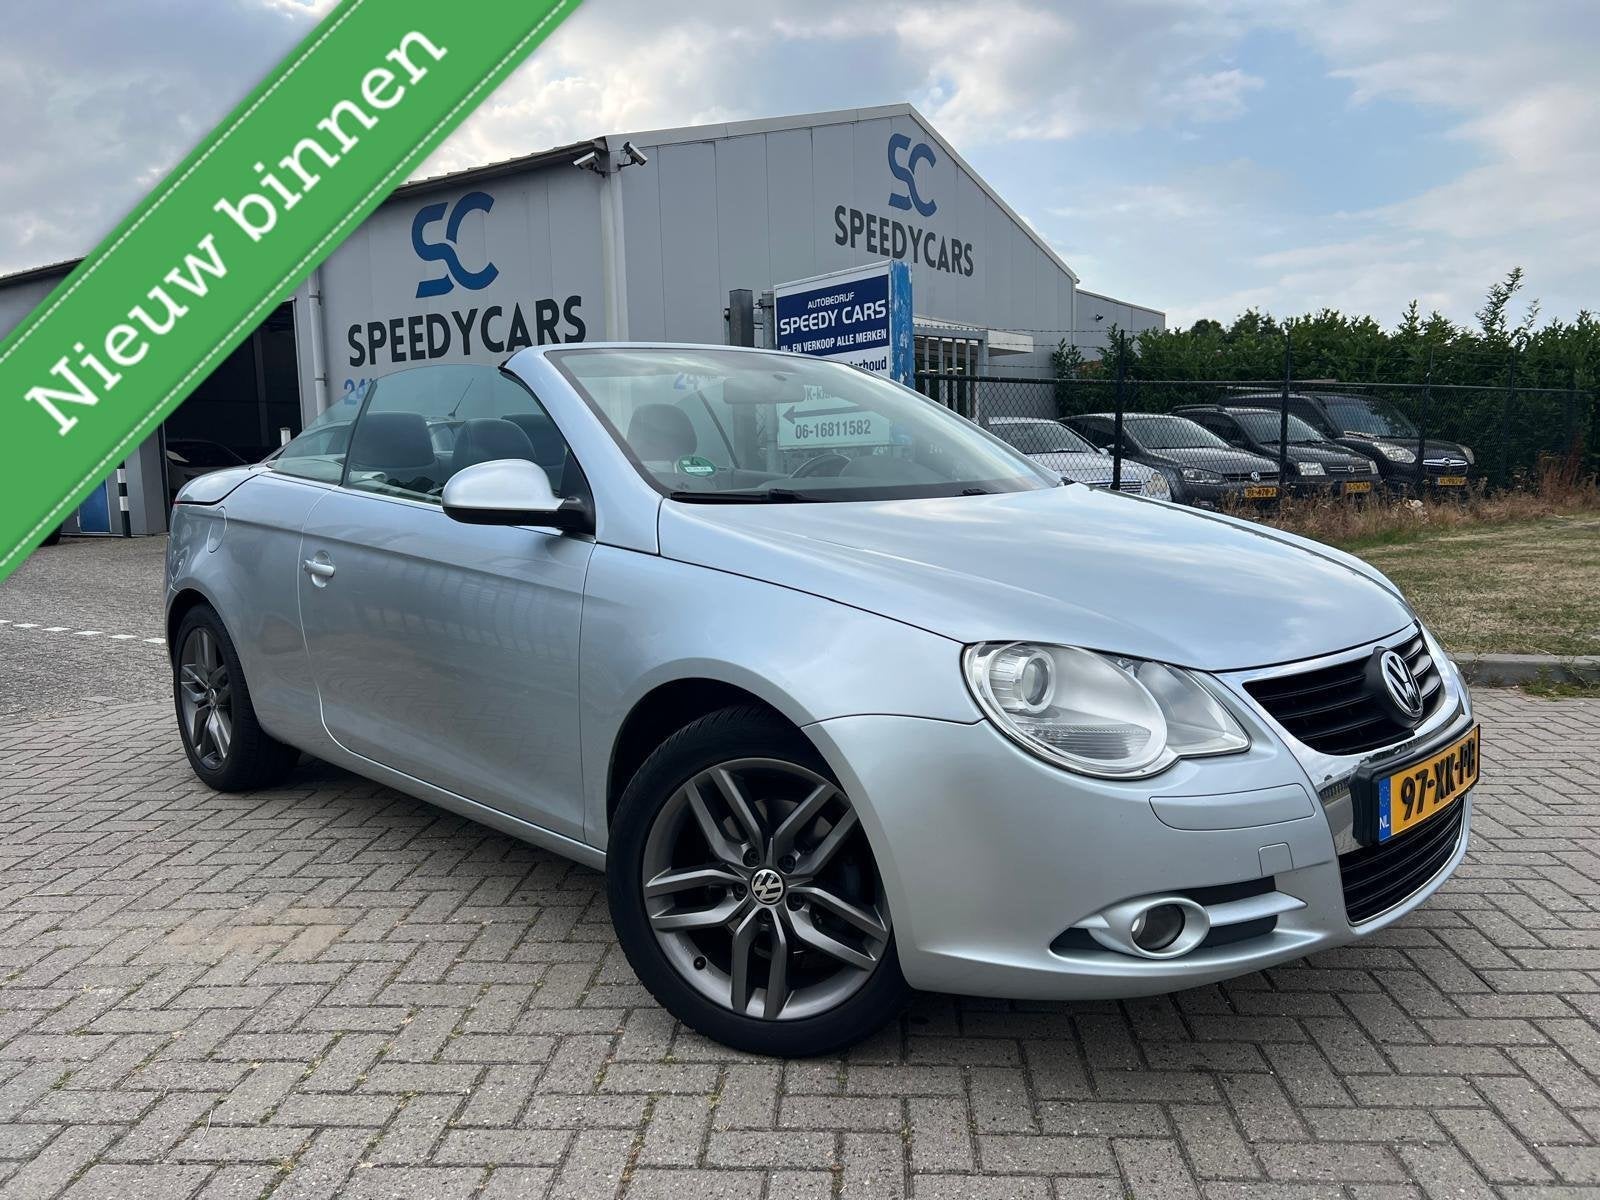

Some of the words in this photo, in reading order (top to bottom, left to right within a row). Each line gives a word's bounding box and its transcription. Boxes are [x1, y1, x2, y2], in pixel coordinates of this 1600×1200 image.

[834, 204, 975, 278] SPEEDYCARS
[807, 291, 856, 310] AUTOBEDRIJF
[780, 308, 839, 336] SPEEDY
[841, 299, 887, 325] CARS
[347, 295, 587, 368] SPEEDYCARS
[802, 337, 835, 353] VERKOOP
[836, 333, 855, 348] ALLE
[855, 328, 887, 344] MERKEN
[795, 418, 872, 440] 06-16811582
[1379, 814, 1390, 831] NL
